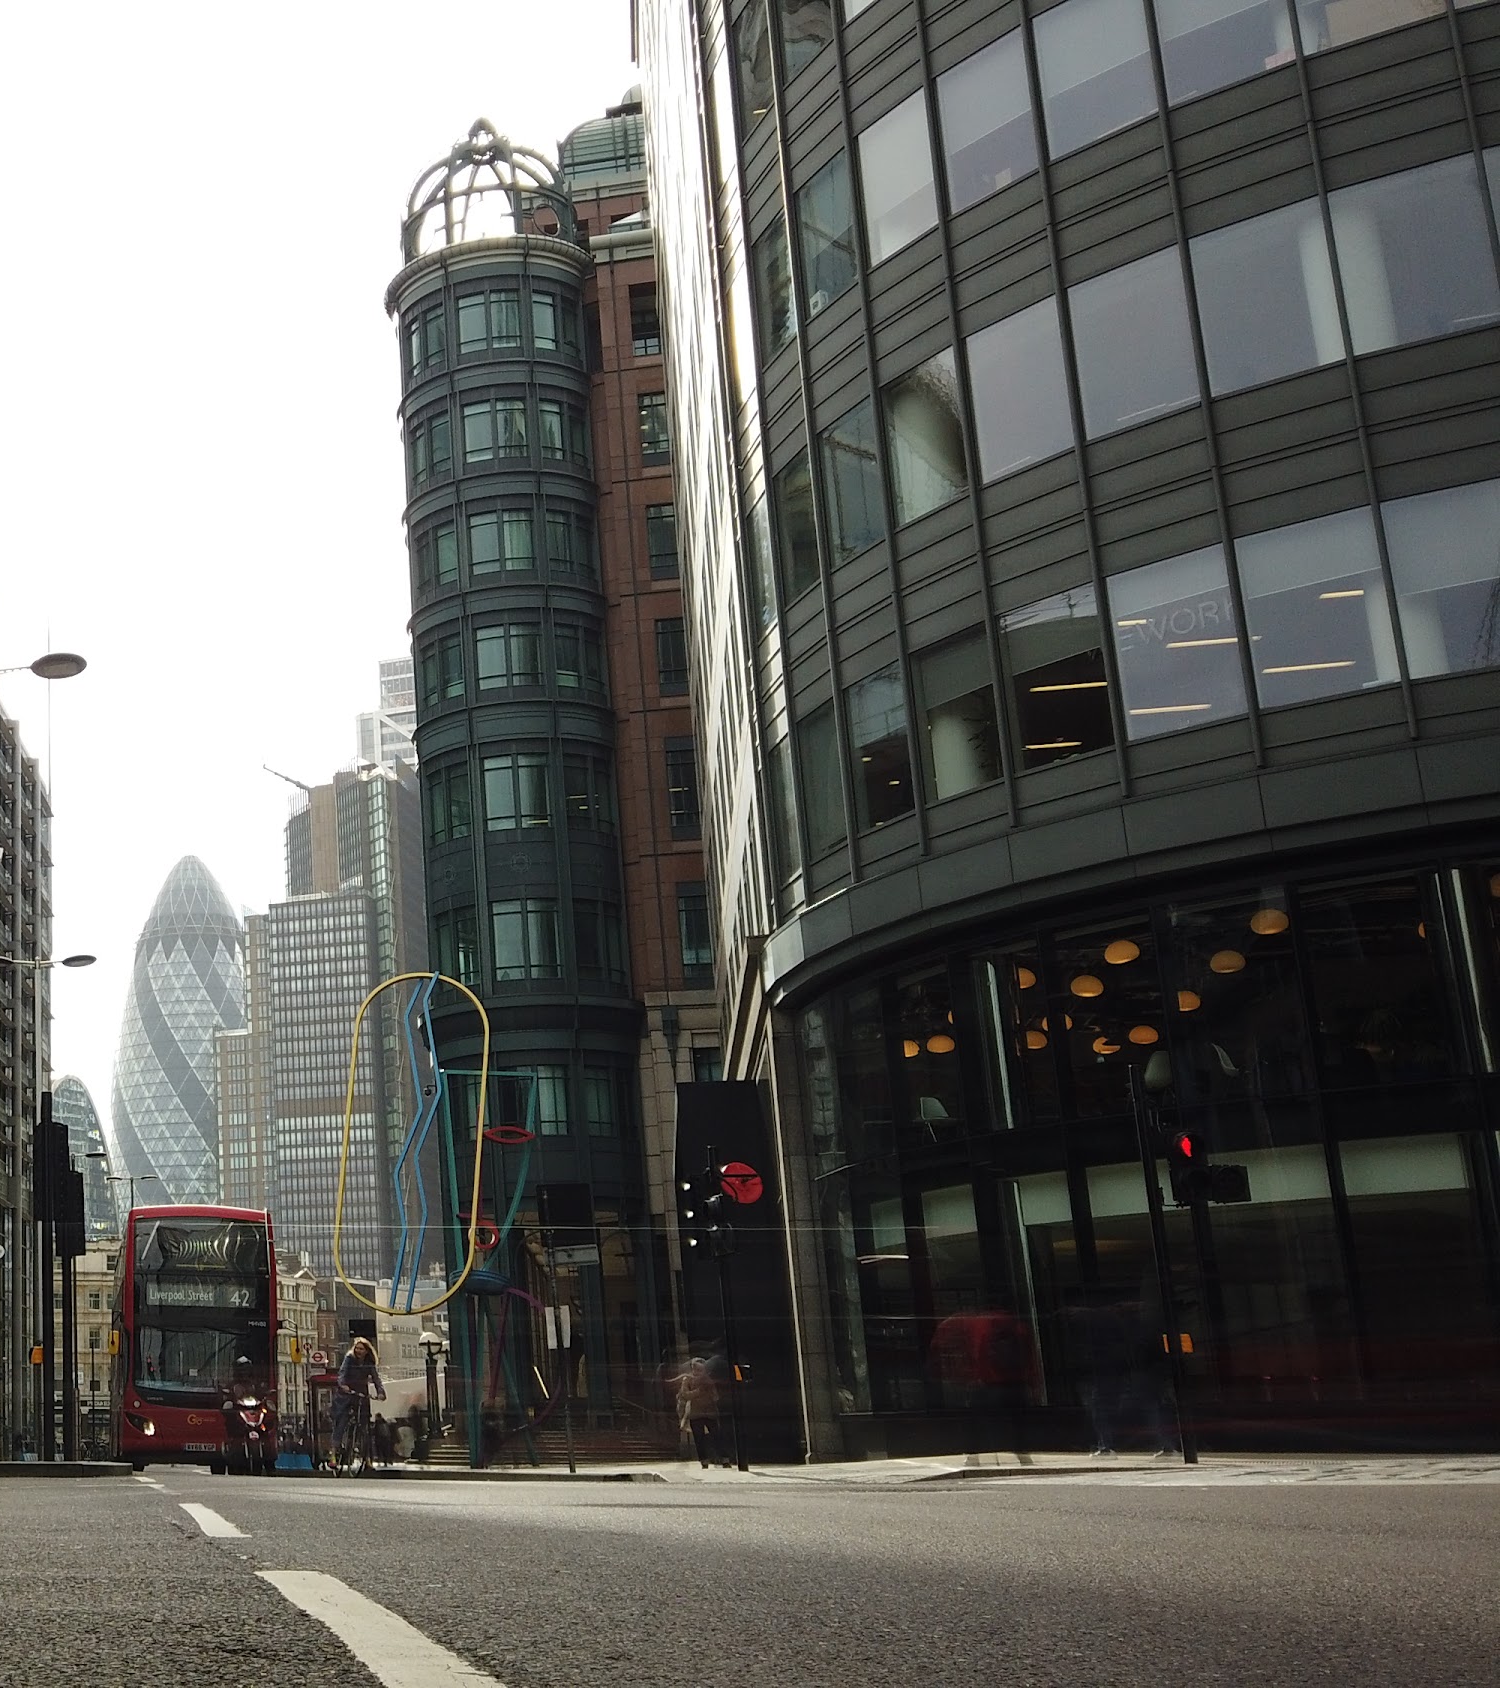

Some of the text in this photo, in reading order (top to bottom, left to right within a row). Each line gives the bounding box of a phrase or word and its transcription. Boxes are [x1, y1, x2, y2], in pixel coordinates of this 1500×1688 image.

[149, 1288, 213, 1303] Liverpool Street
[230, 1290, 250, 1307] 42
